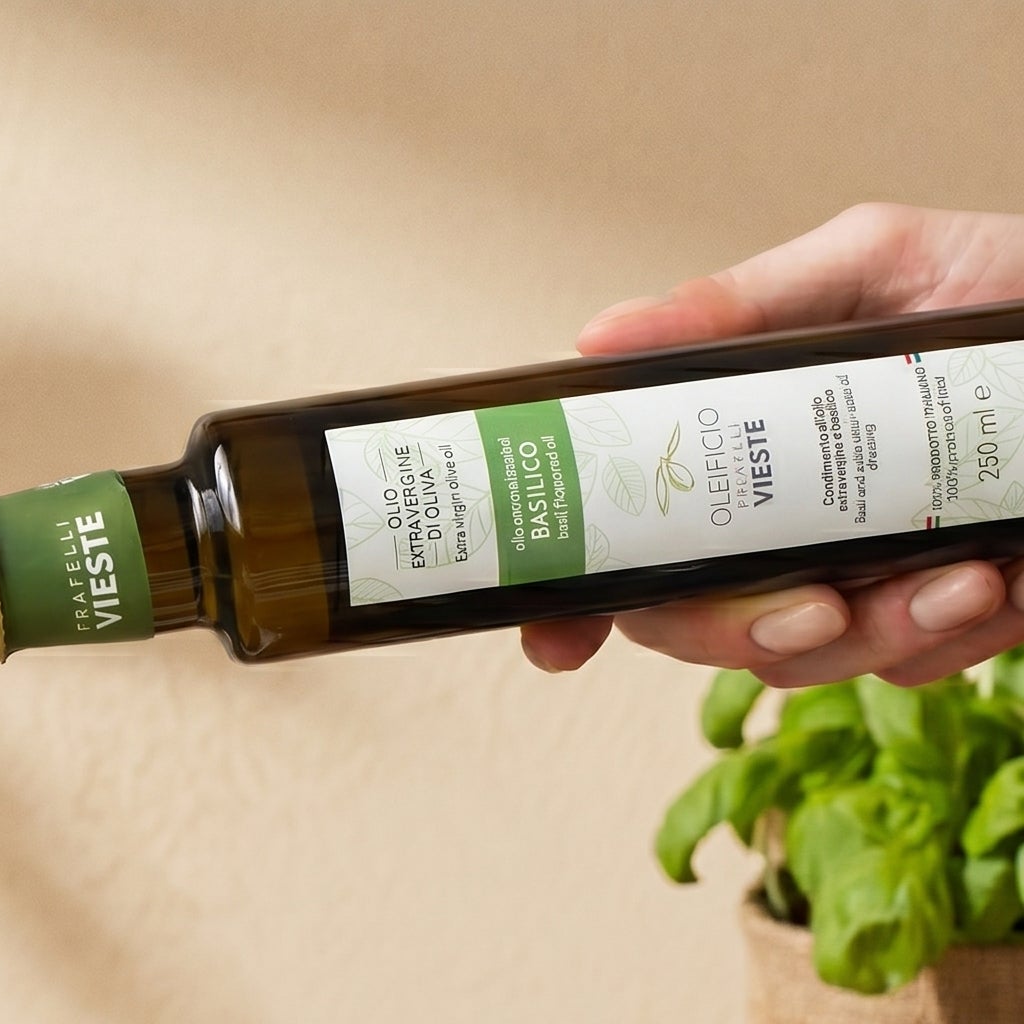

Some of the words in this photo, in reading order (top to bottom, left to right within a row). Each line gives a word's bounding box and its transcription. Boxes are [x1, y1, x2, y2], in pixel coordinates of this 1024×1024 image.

[972, 408, 997, 435] ml
[420, 468, 441, 519] OLIVA
[519, 441, 551, 540] BASILICO
[698, 407, 732, 527] OLEIFICIO
[744, 418, 774, 508] VIESTE
[976, 442, 1000, 482] 250
[384, 488, 402, 530] OLIO
[395, 445, 425, 569] EXTRAVERGINE
[427, 523, 442, 540] DI
[75, 511, 123, 630] VIESTE
